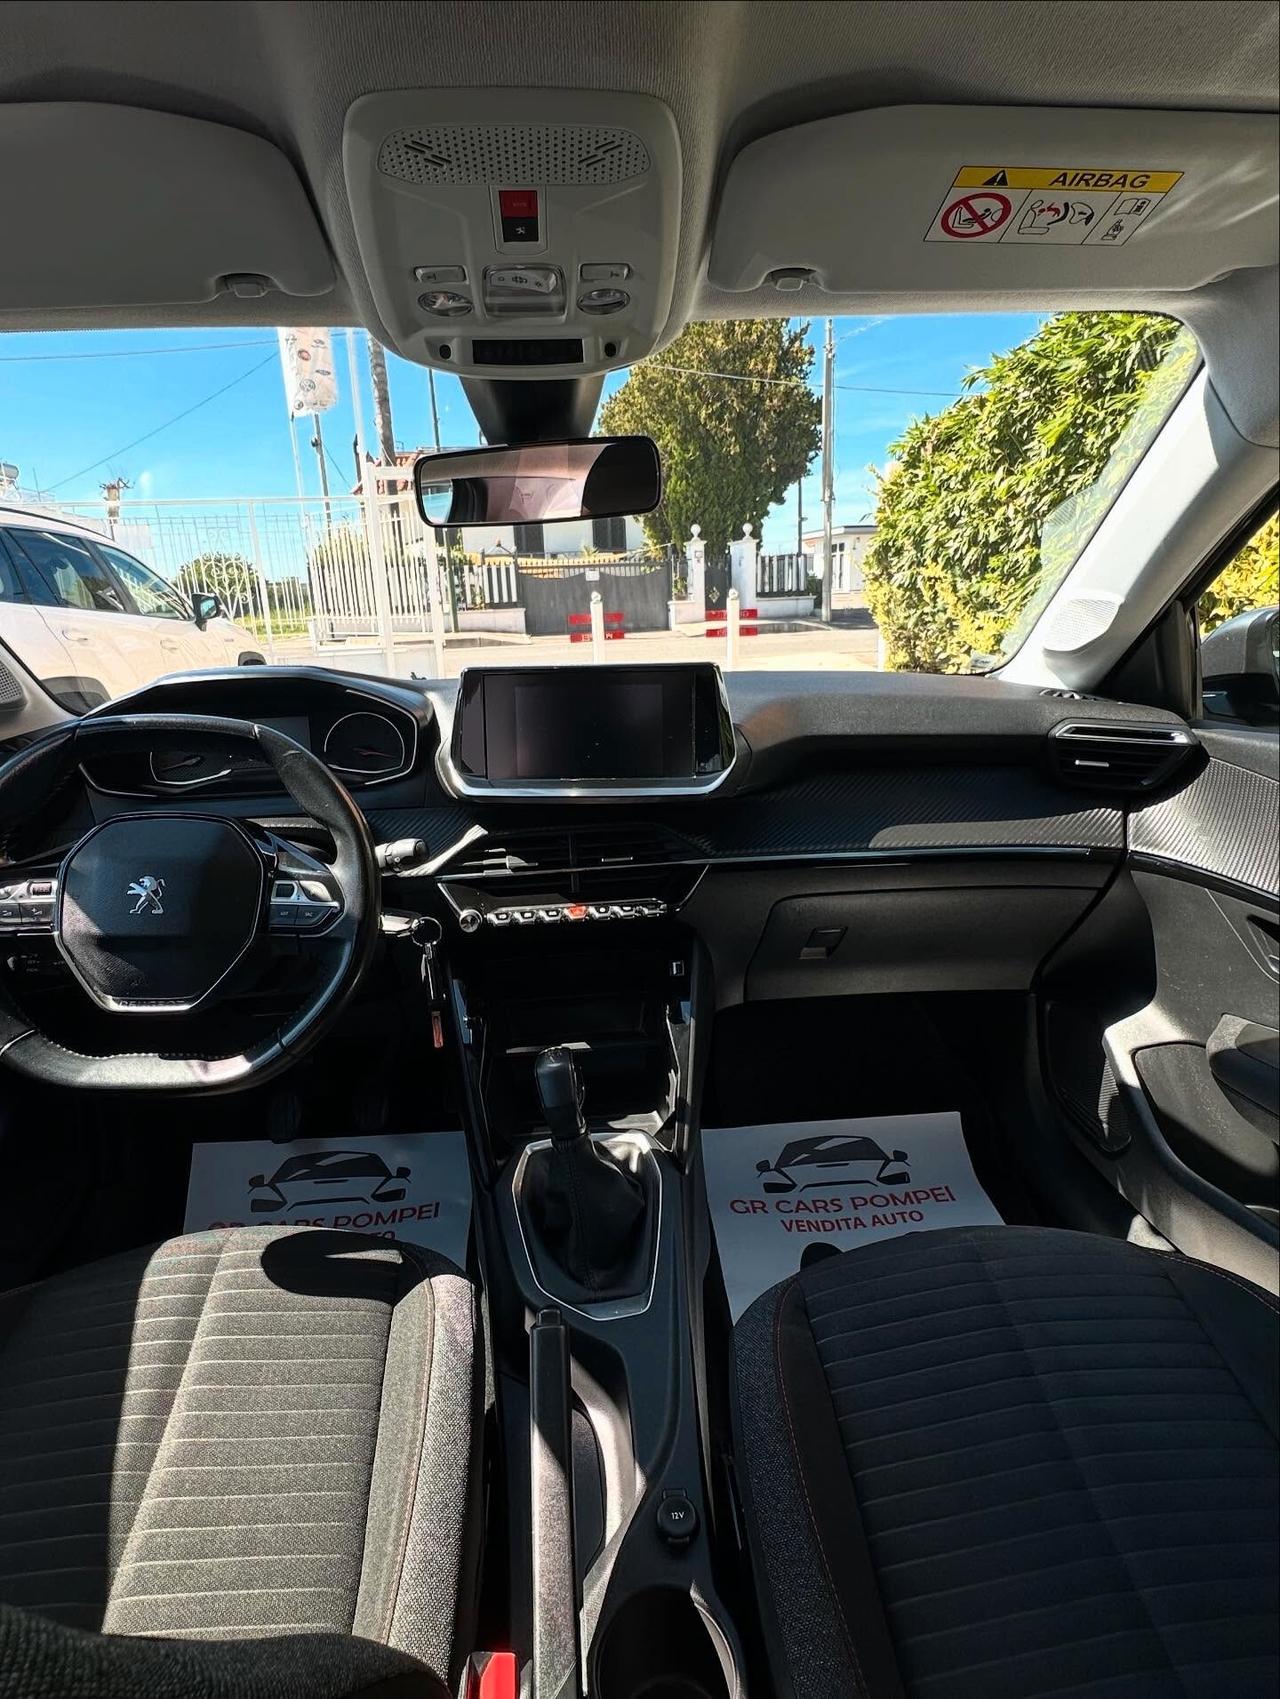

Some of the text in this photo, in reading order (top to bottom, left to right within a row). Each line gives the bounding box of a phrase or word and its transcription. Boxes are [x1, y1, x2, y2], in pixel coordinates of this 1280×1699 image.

[1048, 171, 1151, 189] AIRBAG
[729, 1185, 957, 1215] GR CARS POMPEI
[332, 1201, 441, 1229] POMPEI
[780, 1209, 924, 1233] VENDITA AUTO
[671, 1511, 685, 1520] 12V
